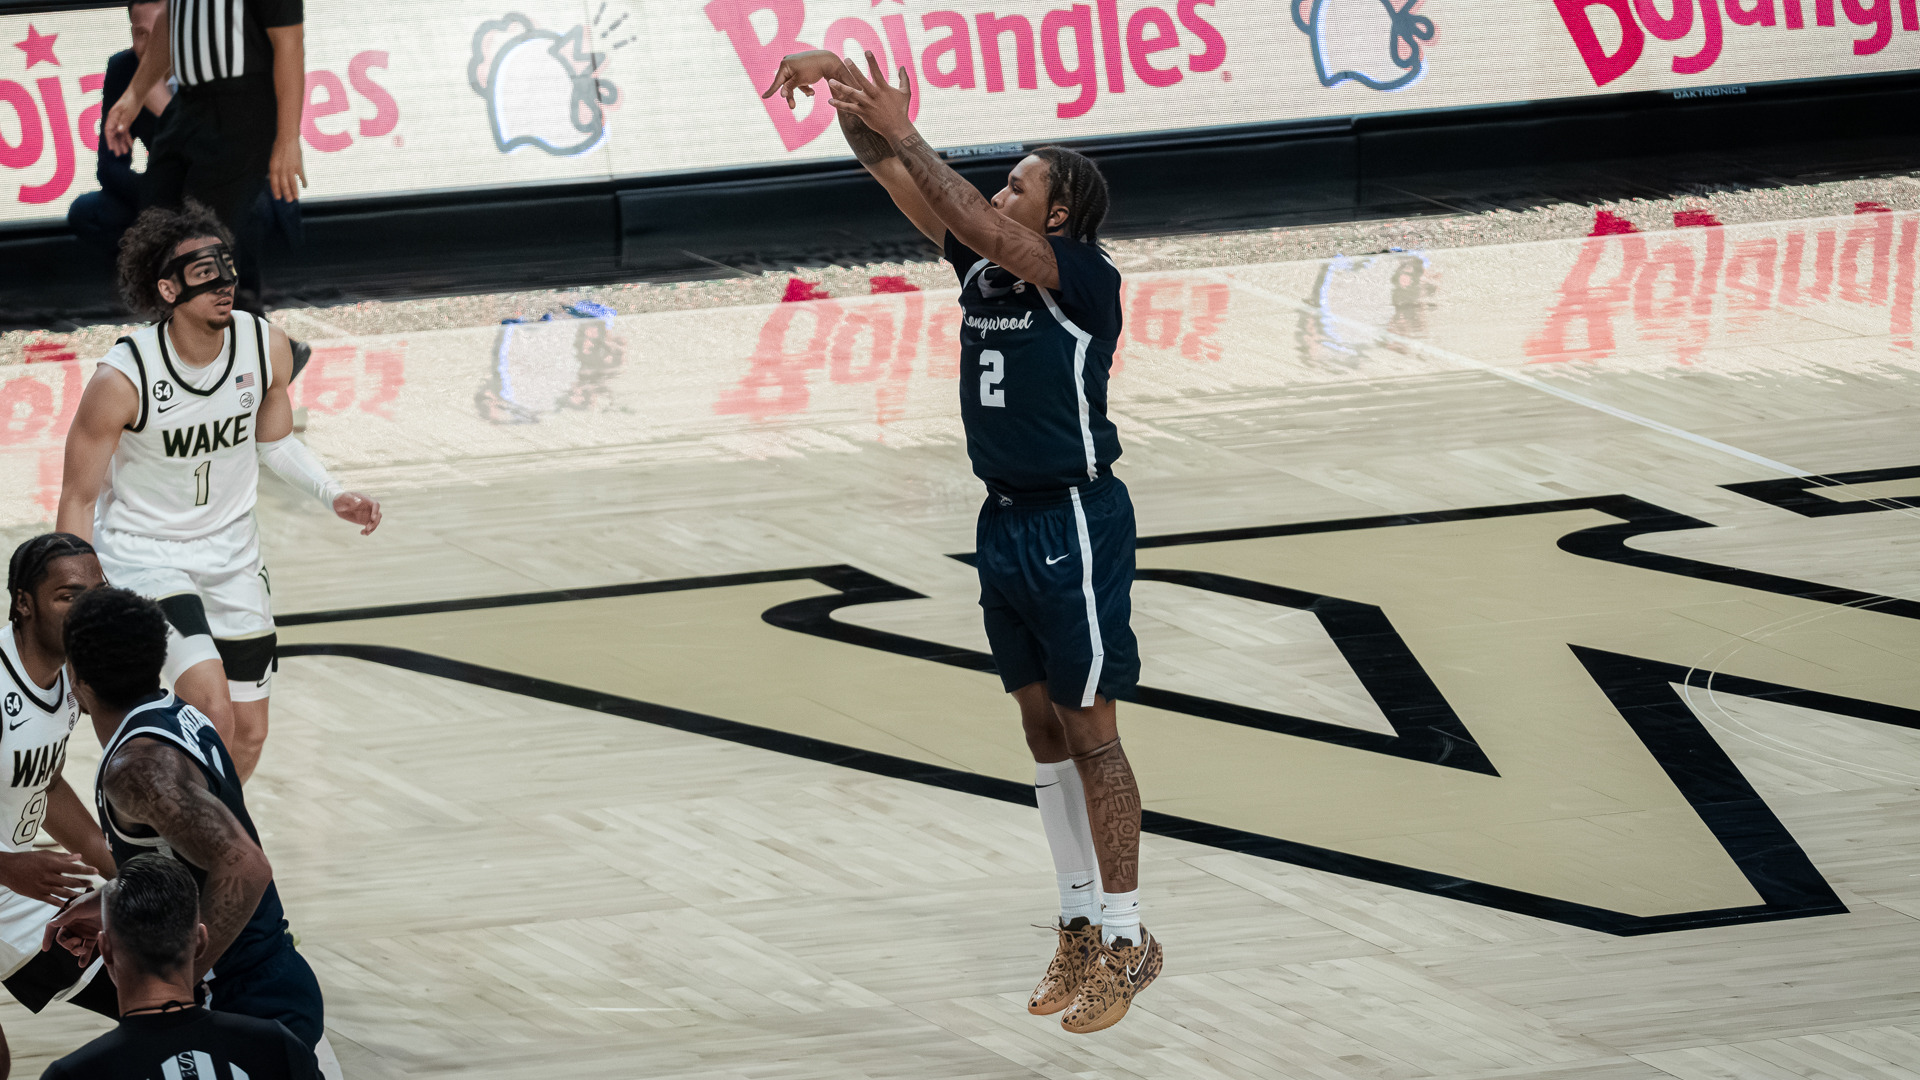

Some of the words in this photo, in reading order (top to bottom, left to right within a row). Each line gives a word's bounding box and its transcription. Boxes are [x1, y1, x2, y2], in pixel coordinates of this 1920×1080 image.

[704, 0, 1228, 152] Bojangles
[154, 383, 172, 400] 54
[979, 349, 1006, 408] 2
[162, 412, 252, 458] WAKE
[194, 460, 211, 506] 1
[6, 695, 21, 713] 54
[12, 789, 47, 846] 8
